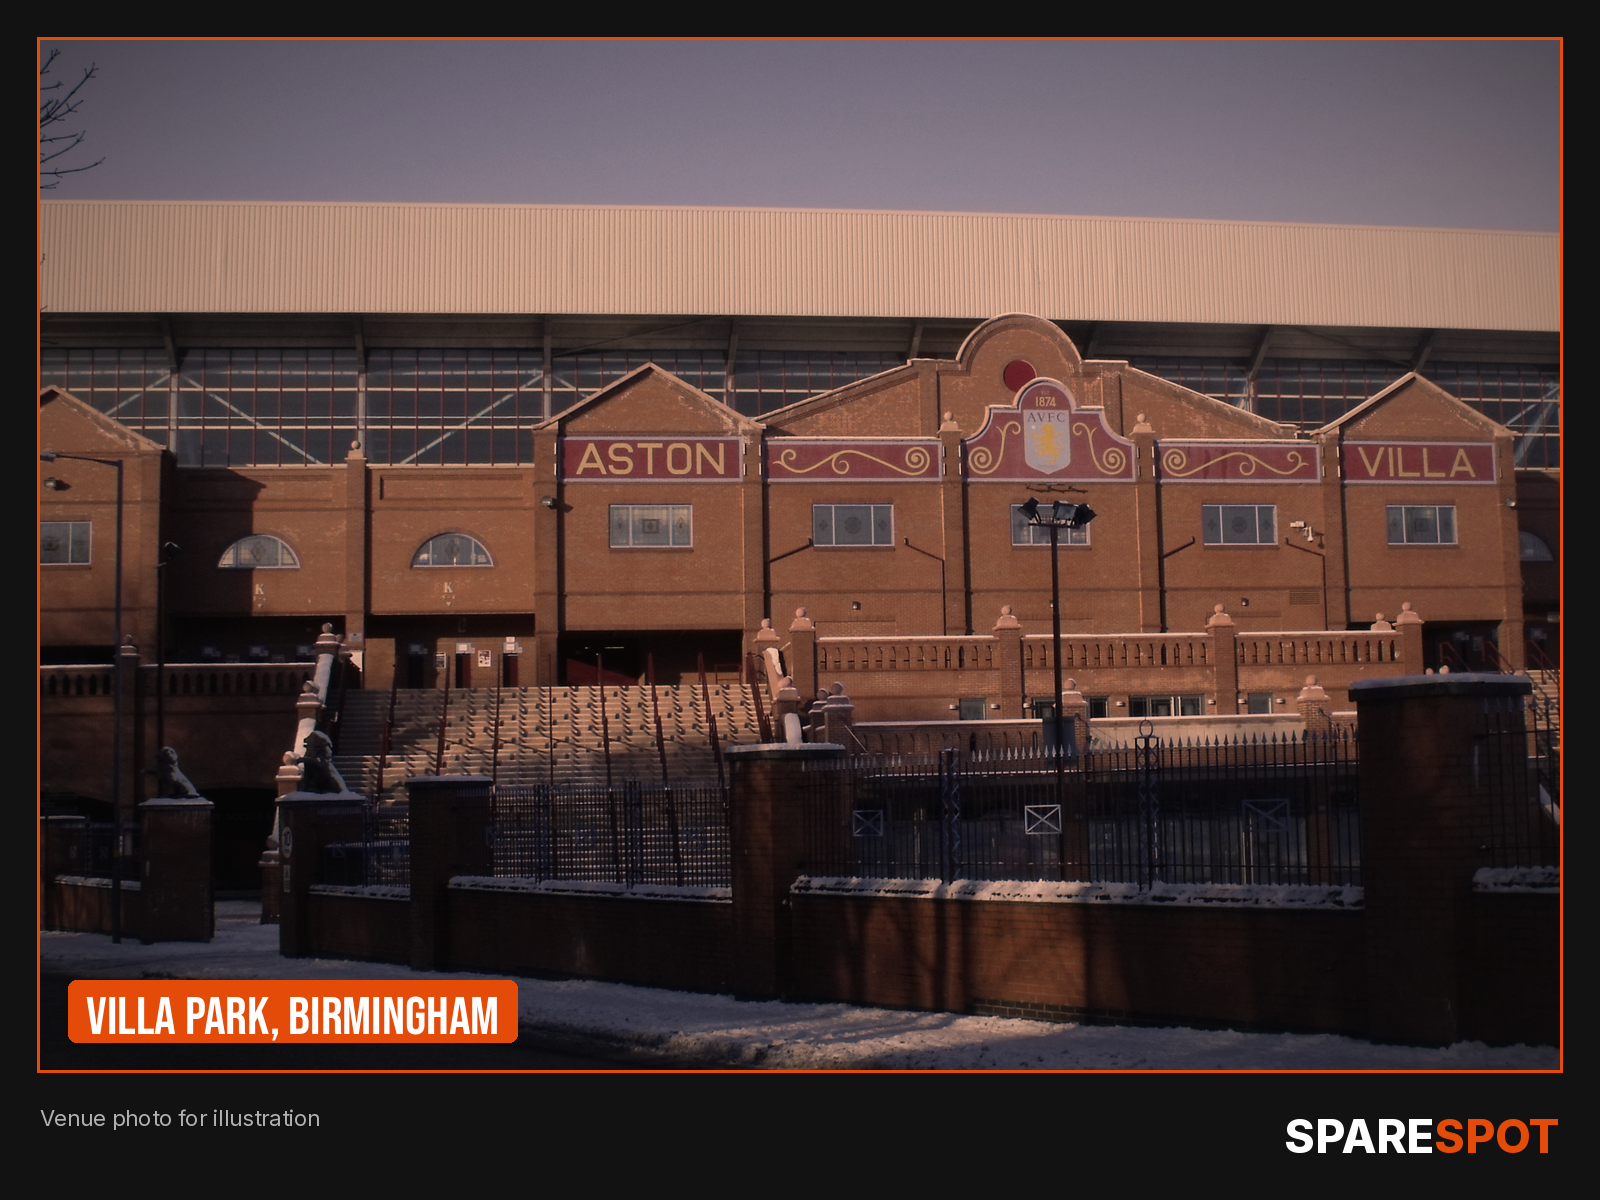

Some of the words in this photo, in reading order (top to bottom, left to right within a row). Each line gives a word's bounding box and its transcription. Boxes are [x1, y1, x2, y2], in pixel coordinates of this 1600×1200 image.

[1035, 396, 1056, 407] 1874
[1028, 412, 1065, 422] AVFC
[575, 442, 725, 475] ASTON
[1357, 446, 1476, 479] VILLA
[255, 583, 265, 595] K
[444, 581, 454, 594] K
